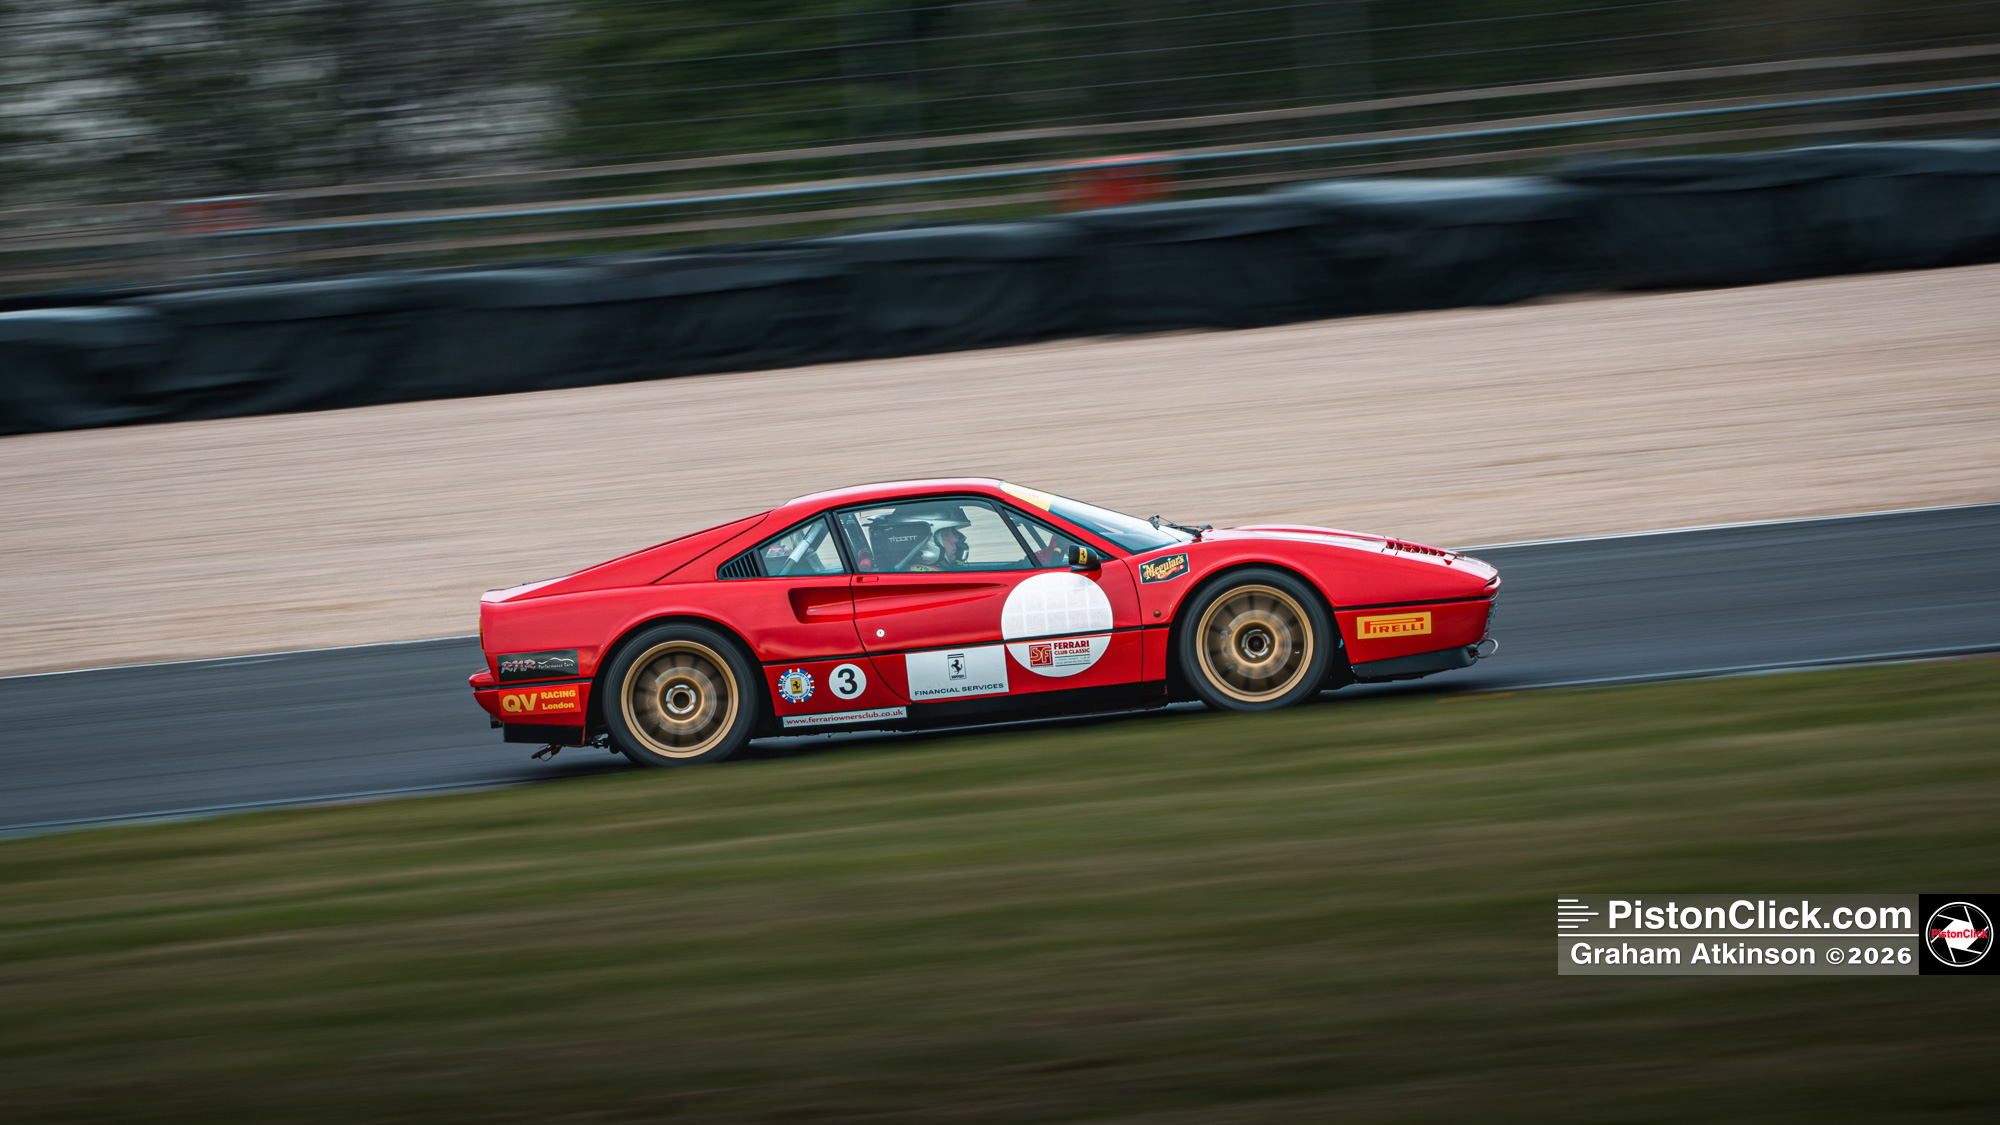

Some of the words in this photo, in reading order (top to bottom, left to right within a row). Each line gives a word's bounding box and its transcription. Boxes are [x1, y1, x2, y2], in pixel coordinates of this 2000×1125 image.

[1364, 617, 1424, 634] PIRELLI
[1053, 640, 1090, 650] FERRARI
[837, 668, 858, 695] 3
[541, 690, 576, 699] RACING
[914, 687, 960, 696] FINANCIAL
[961, 683, 1004, 692] SERVICES
[502, 693, 538, 713] QV
[542, 702, 575, 710] London
[786, 709, 903, 725] www.ferrariownersclub.co.uk
